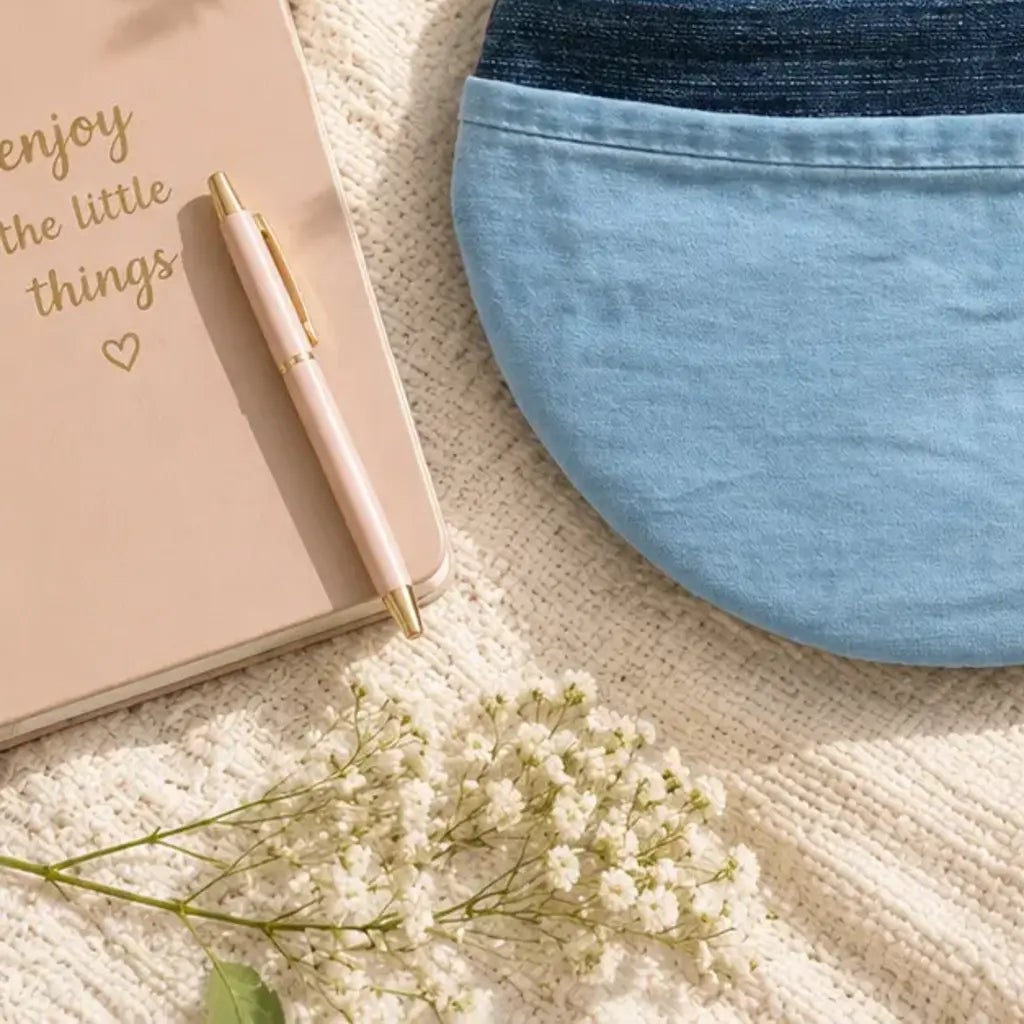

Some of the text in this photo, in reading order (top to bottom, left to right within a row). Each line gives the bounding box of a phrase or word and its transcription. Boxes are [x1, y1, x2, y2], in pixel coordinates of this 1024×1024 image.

[0, 105, 133, 182] enjoy
[0, 175, 173, 255] the little
[25, 249, 178, 317] things
